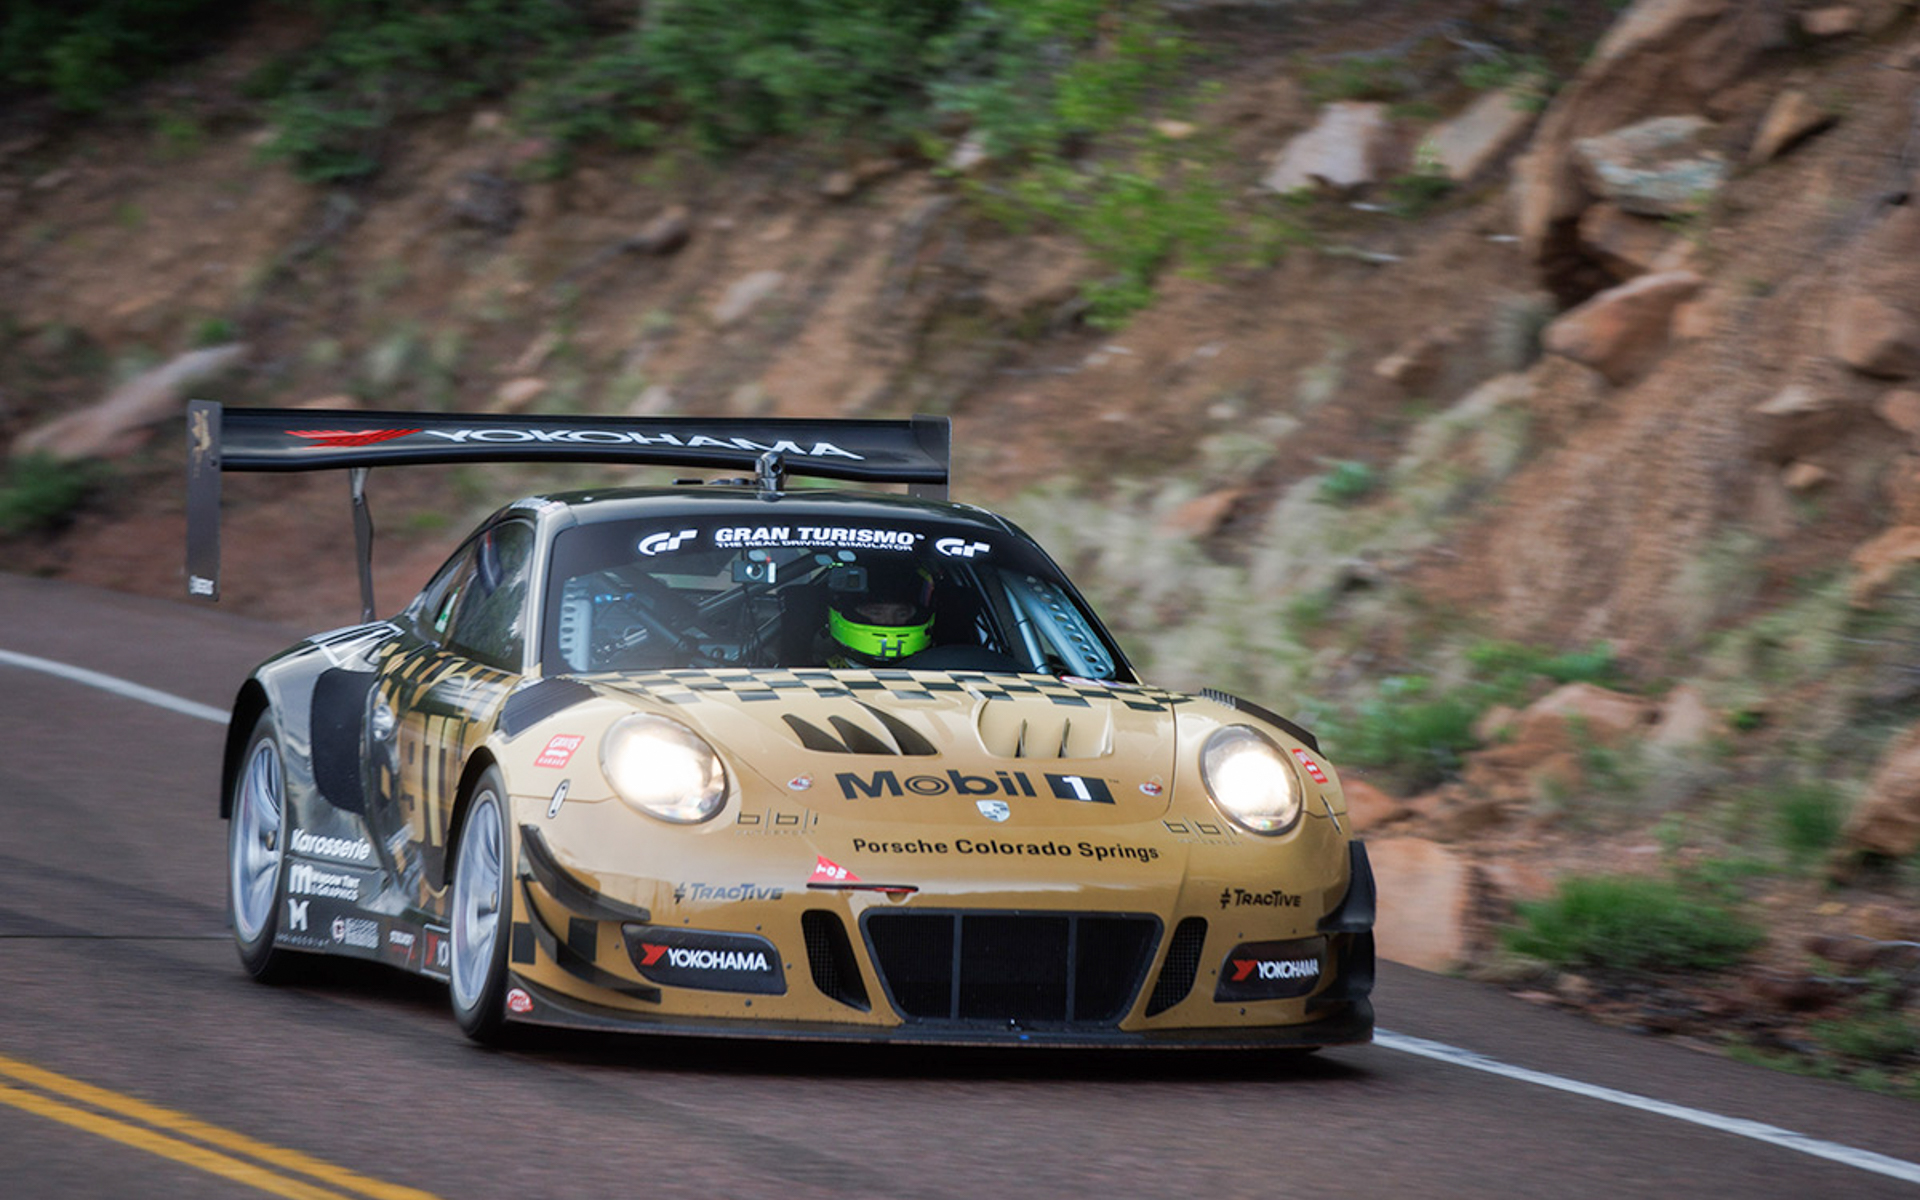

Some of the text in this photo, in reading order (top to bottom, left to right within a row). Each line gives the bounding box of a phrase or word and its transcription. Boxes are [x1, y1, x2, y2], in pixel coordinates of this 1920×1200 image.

[424, 429, 865, 461] YOKOHAMA
[715, 527, 790, 542] GRAN
[837, 540, 913, 551] SIMULATOR
[835, 770, 1037, 800] Mobil
[291, 828, 371, 861] Karosserie
[853, 838, 1159, 863] Porsche Colorado Springs
[816, 863, 848, 880] TOW
[667, 947, 768, 972] YOKOHAMA
[1256, 957, 1320, 980] YOKOHAMA
